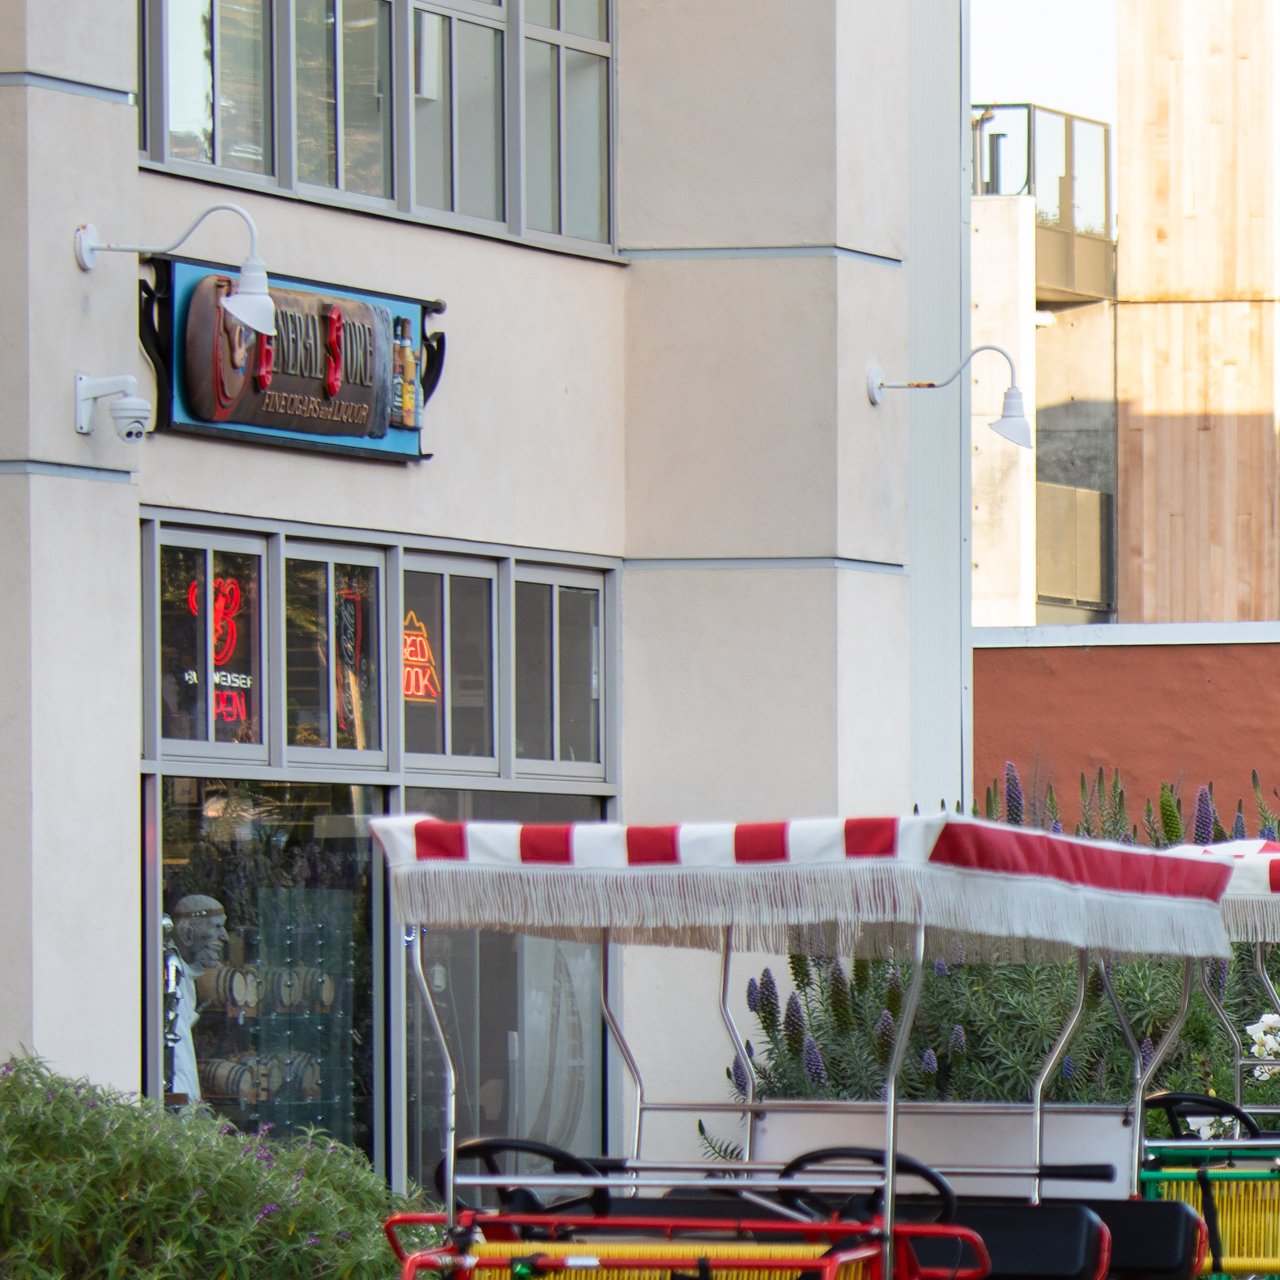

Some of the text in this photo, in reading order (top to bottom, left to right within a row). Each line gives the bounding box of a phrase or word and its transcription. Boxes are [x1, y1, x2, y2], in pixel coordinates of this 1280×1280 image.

[262, 391, 288, 414] FINE
[287, 393, 321, 418] CIGARS
[403, 667, 437, 697] OOK
[213, 690, 247, 722] PEN
